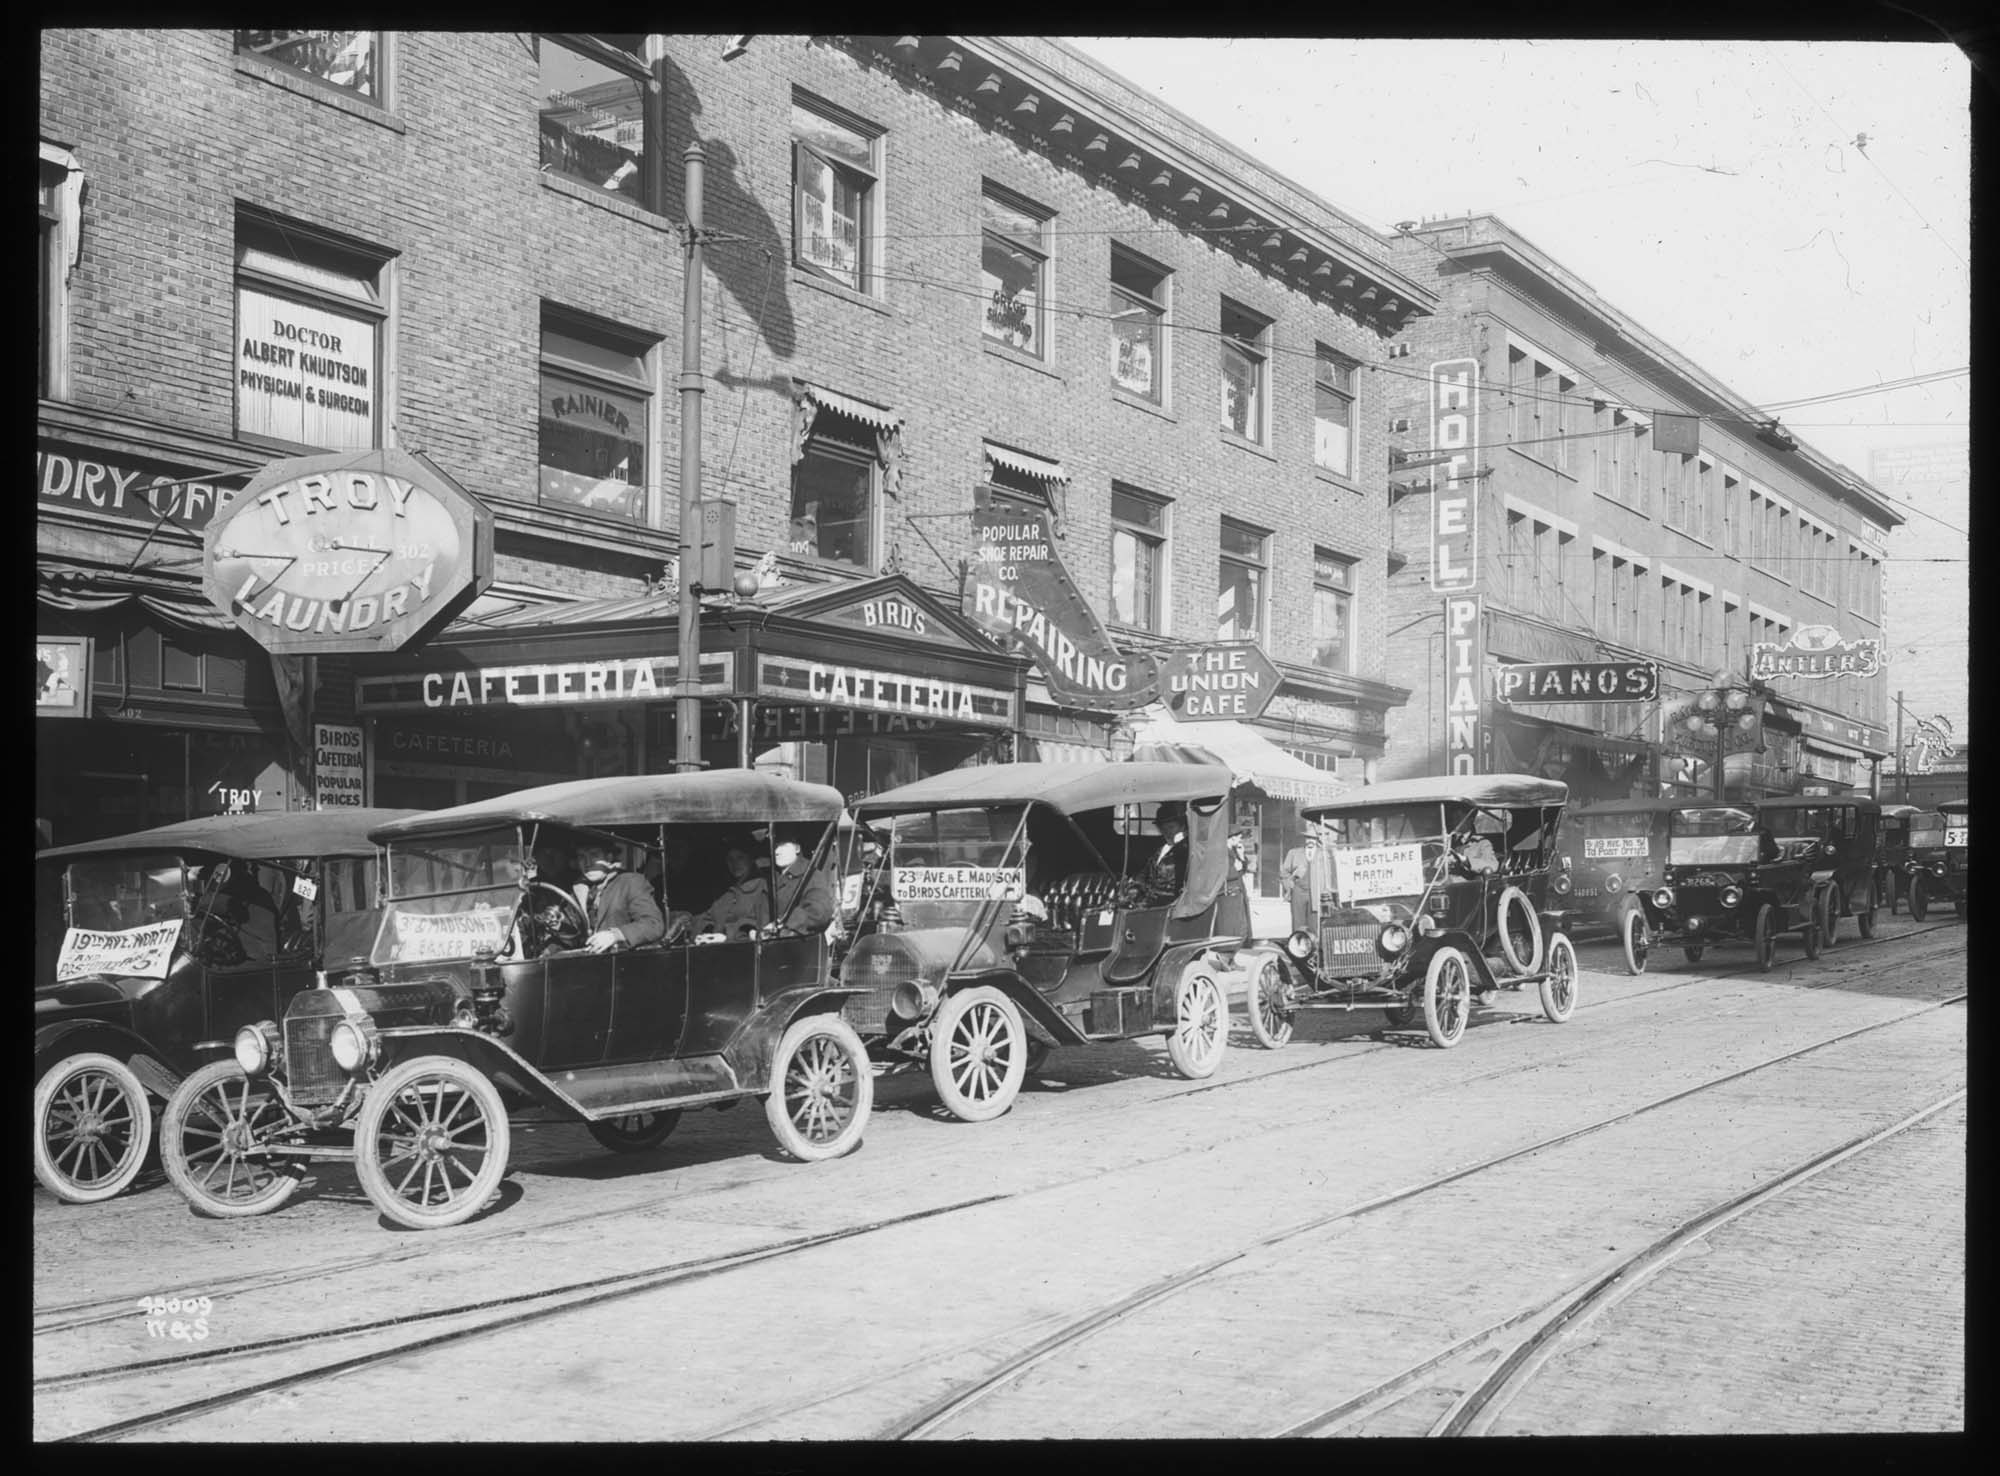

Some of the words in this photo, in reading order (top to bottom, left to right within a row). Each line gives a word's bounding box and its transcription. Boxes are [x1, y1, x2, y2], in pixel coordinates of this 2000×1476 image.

[272, 319, 342, 352] DOCTOR
[242, 338, 295, 368] ALBERT
[300, 352, 367, 388] KNUDTSON
[240, 369, 301, 400] PHYSICIAN
[305, 385, 316, 403] &
[318, 388, 369, 417] SURGEON
[552, 393, 629, 434] RAINIER
[37, 451, 141, 508] DRY
[1438, 371, 1468, 580] HOTEL
[257, 472, 415, 526] TROY
[982, 524, 1040, 542] POPULAR
[789, 540, 810, 556] 109
[978, 545, 1007, 562] SHOE
[1009, 545, 1049, 561] REPAIR
[303, 556, 385, 578] PRICES
[999, 566, 1019, 581] CO.
[233, 562, 435, 635] LAUNDRY
[863, 601, 926, 635] BIRD'S
[975, 583, 1128, 692] REPAIRING
[1187, 651, 1247, 671] THE
[1760, 649, 1875, 674] ANTLERS
[1170, 672, 1260, 692] UNION
[1503, 667, 1649, 697] PIANOS
[319, 728, 361, 748] BIRD'S
[393, 731, 514, 758] CAFETERIA
[315, 748, 364, 769] CAFETERIA
[316, 775, 362, 790] POPULAR
[218, 788, 262, 807] TROY
[319, 793, 361, 807] PRICES
[1355, 849, 1414, 866] EASTLAKE
[1598, 847, 1618, 856] POST
[969, 870, 1021, 884] MADISON
[1353, 868, 1393, 881] MARTIN
[897, 890, 907, 898] TO
[909, 885, 941, 898] BIRD'S
[133, 927, 177, 949] NORTH
